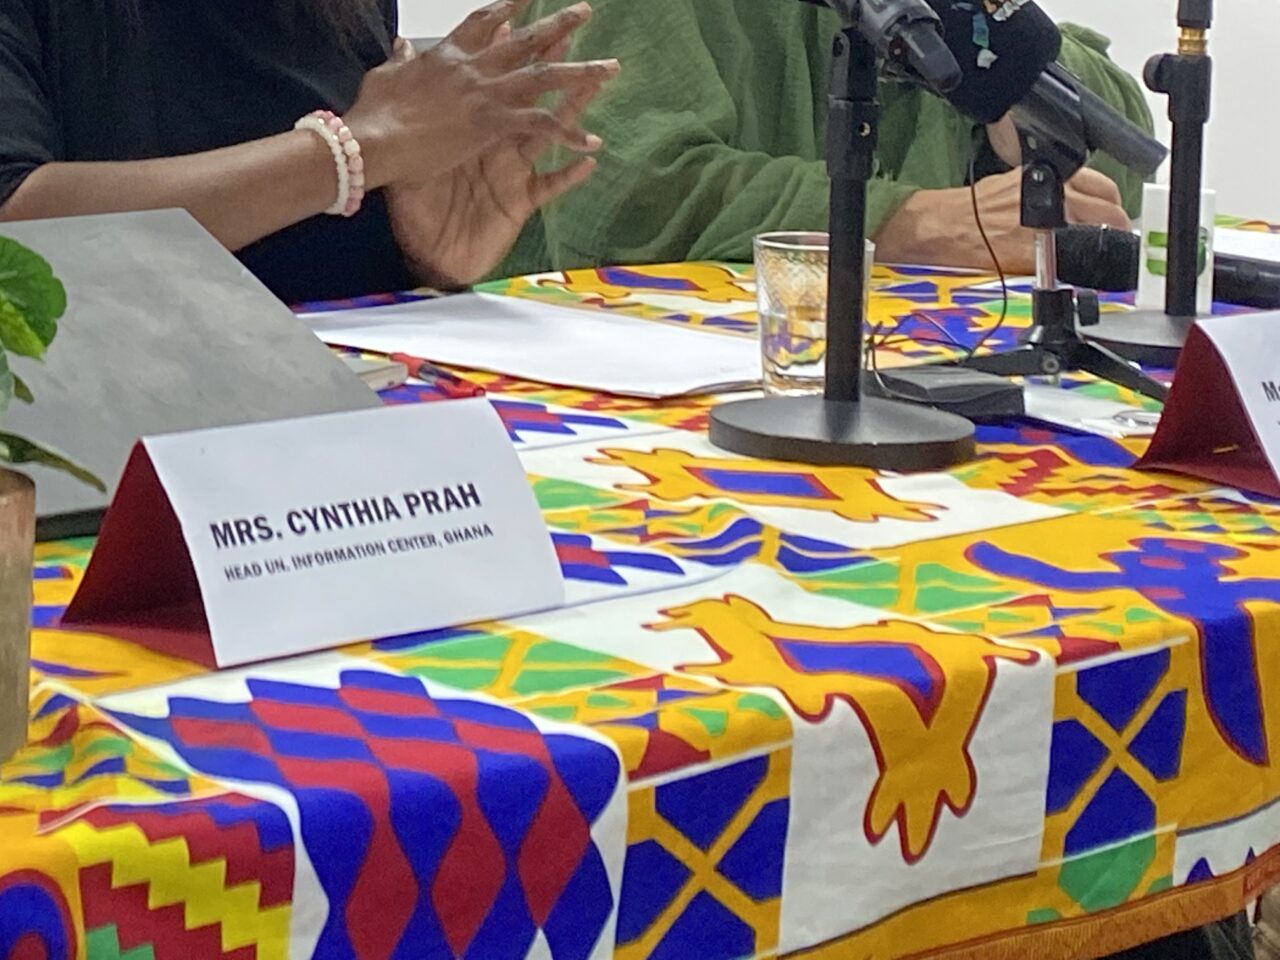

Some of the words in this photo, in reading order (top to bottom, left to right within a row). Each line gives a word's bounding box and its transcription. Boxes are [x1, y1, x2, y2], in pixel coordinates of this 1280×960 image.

[209, 516, 283, 551] MRS.
[286, 496, 402, 535] CYNTHIA
[403, 482, 483, 518] PRAH
[224, 563, 263, 582] HEAD
[264, 557, 290, 575] UN.
[291, 541, 386, 570] INFORMATION
[387, 533, 444, 554] CENTER,
[443, 523, 494, 544] GHANA
